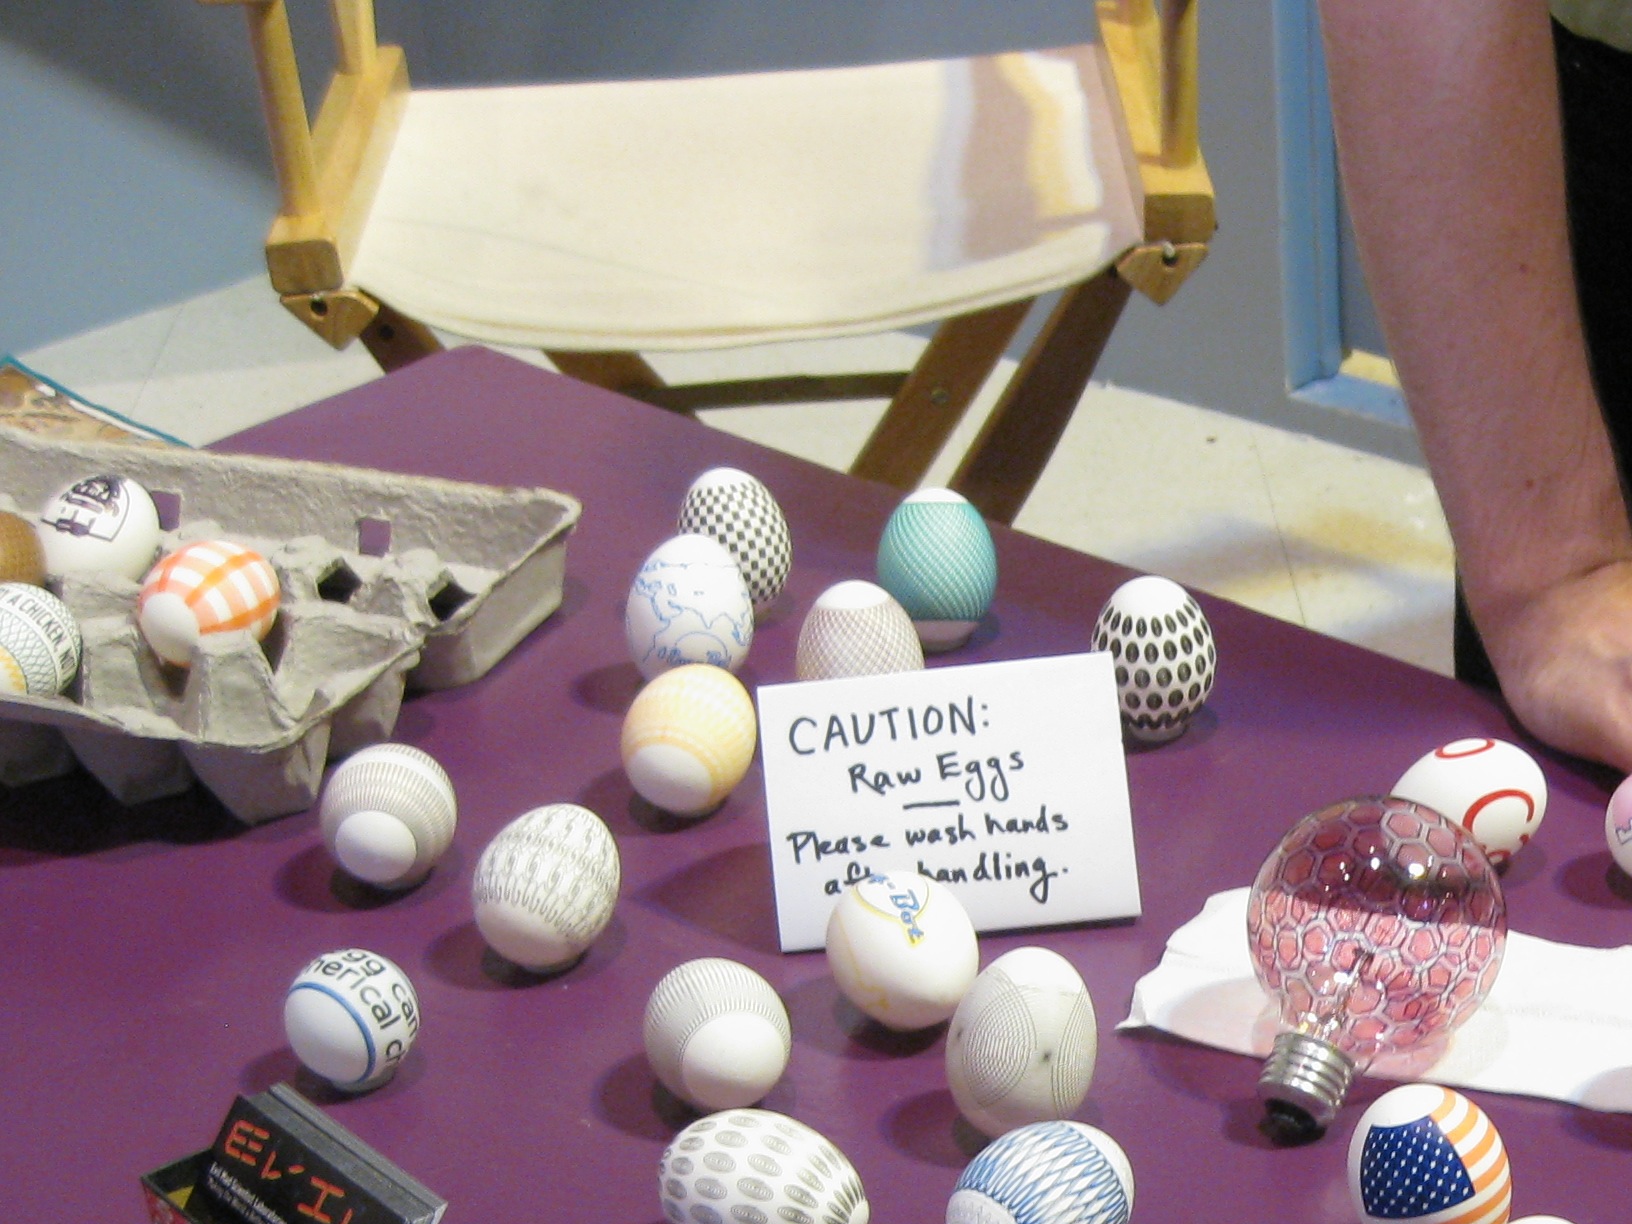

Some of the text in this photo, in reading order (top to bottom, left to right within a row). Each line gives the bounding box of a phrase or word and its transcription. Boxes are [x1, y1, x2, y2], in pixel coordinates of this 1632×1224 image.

[788, 695, 990, 756] CAUTION:
[847, 750, 1025, 802] Raw Eggs
[786, 803, 1069, 865] Please wash hands
